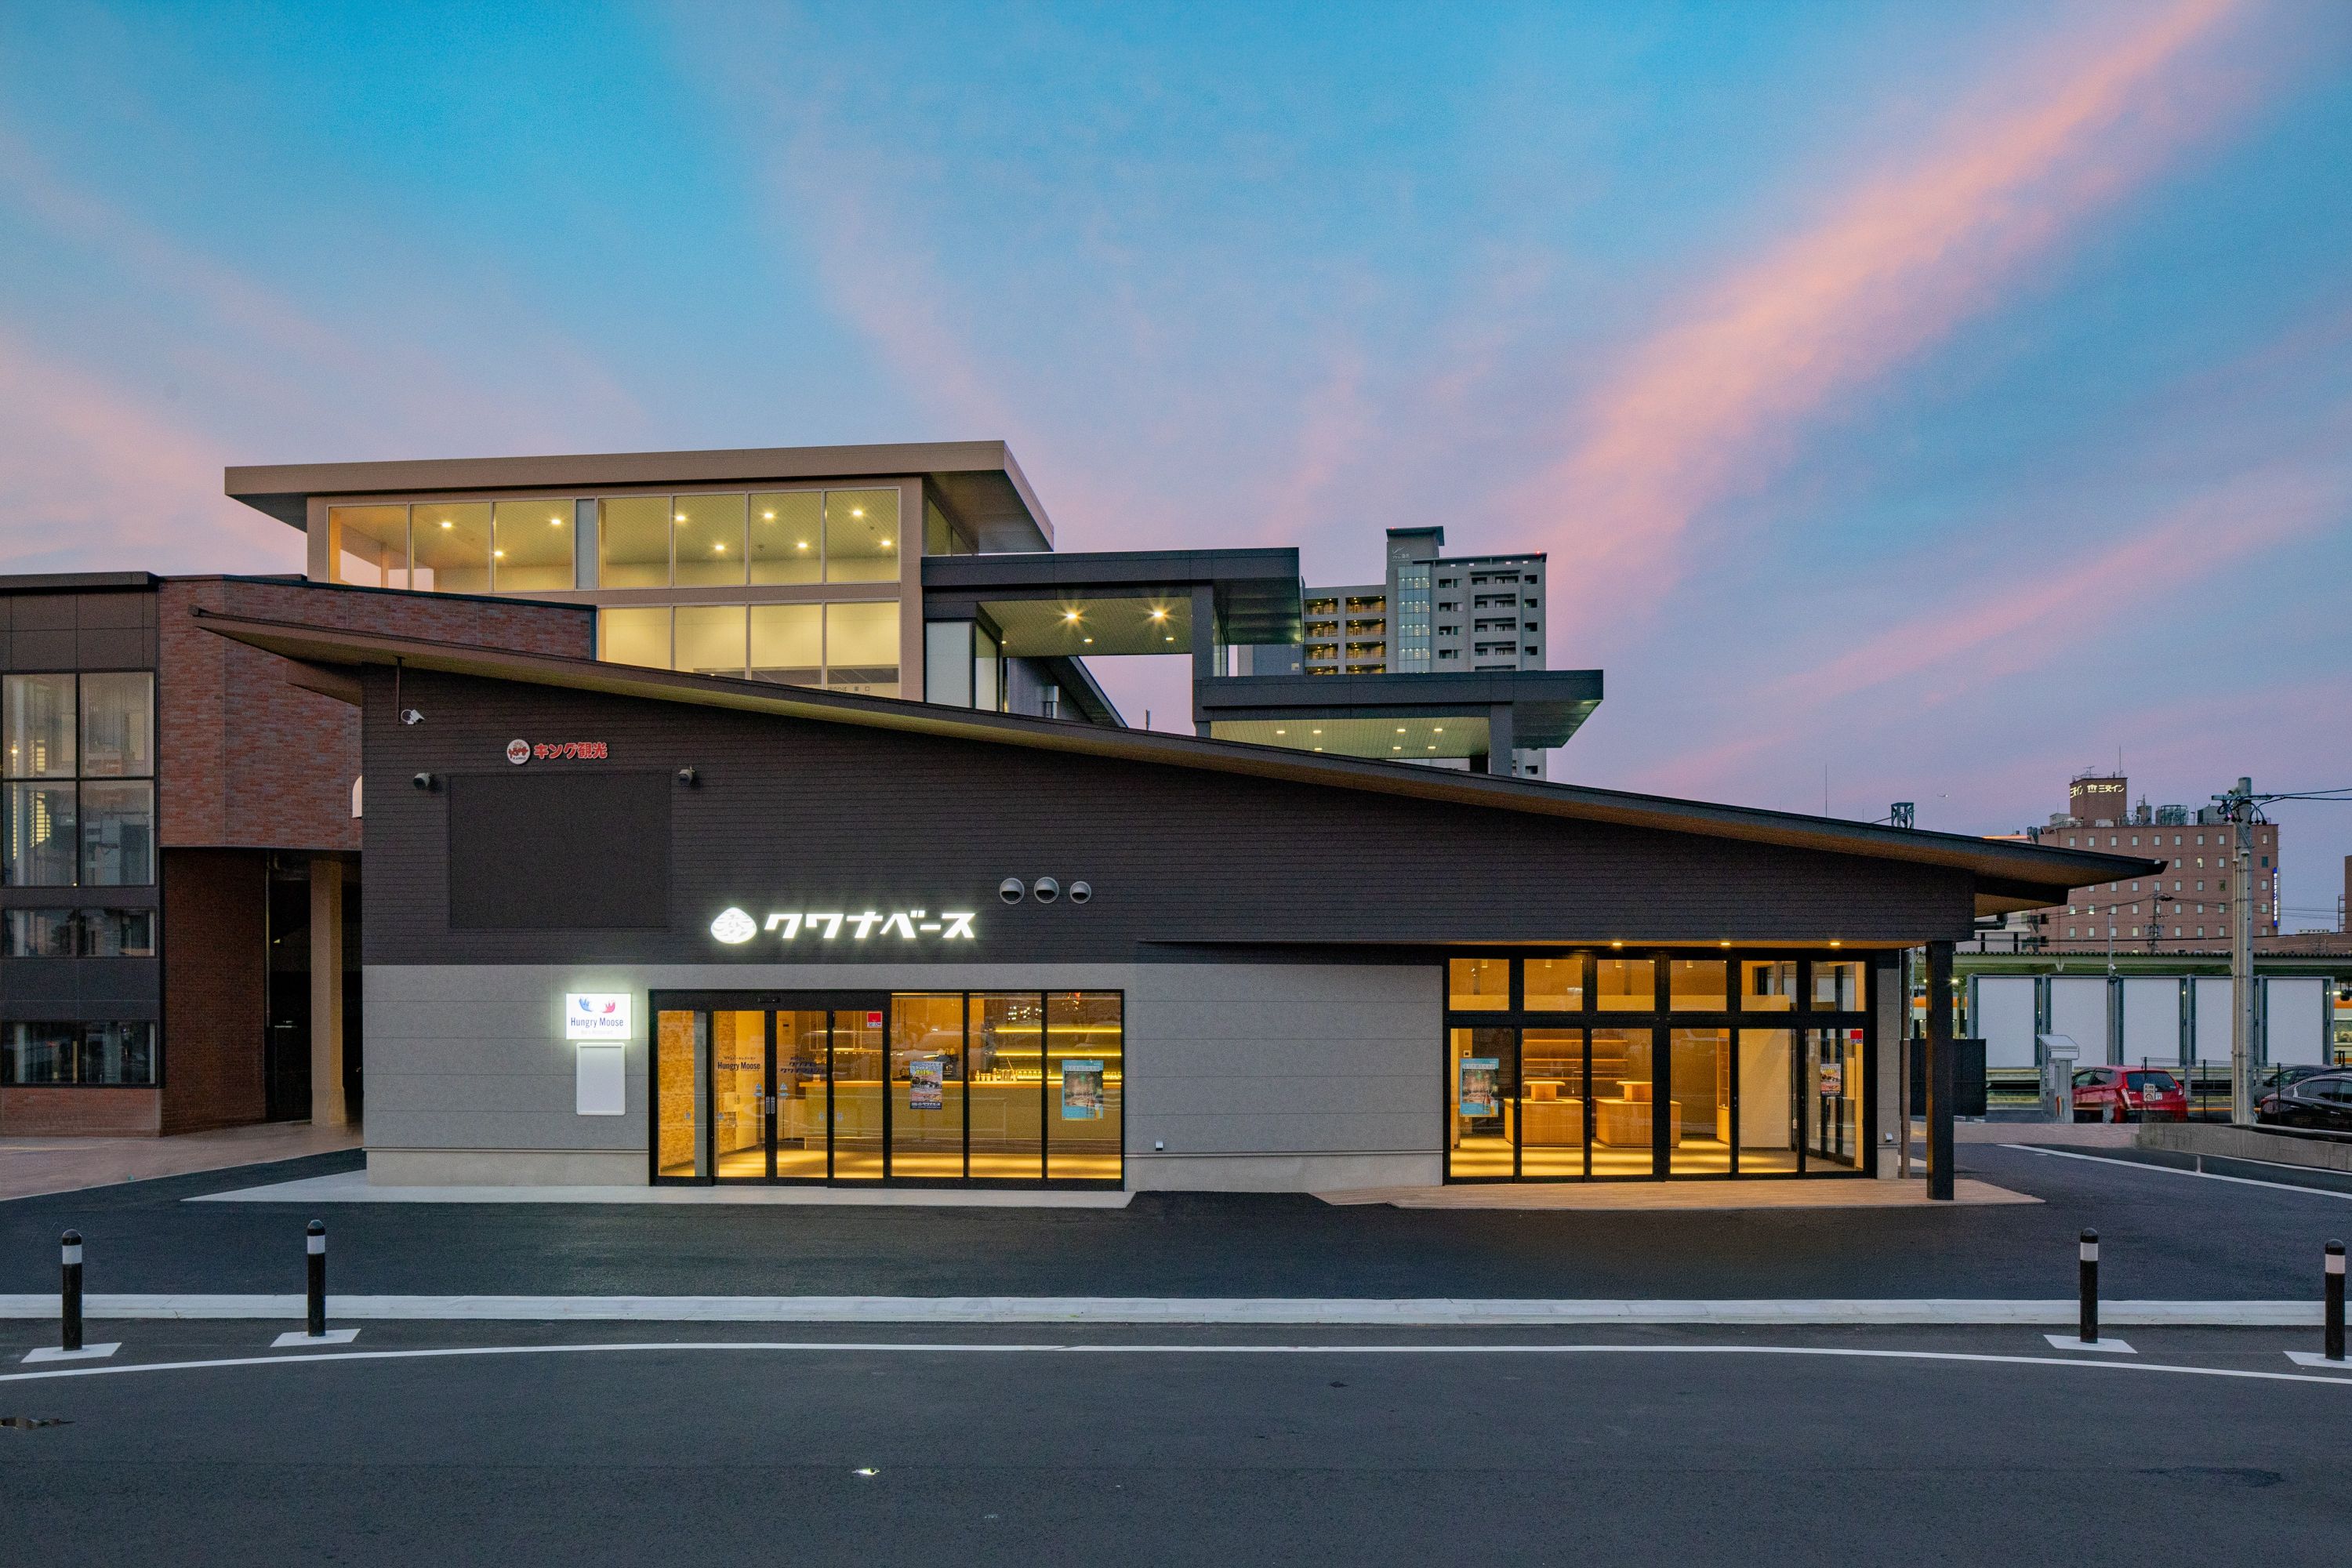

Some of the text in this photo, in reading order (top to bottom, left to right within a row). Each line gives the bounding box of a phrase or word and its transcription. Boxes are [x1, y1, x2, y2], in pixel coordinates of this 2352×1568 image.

[534, 742, 608, 759] キング観光
[2098, 784, 2125, 793] 三交イン
[764, 909, 976, 938] クワナベース
[571, 1017, 624, 1028] Hungry Moose
[717, 1062, 739, 1071] Hungry
